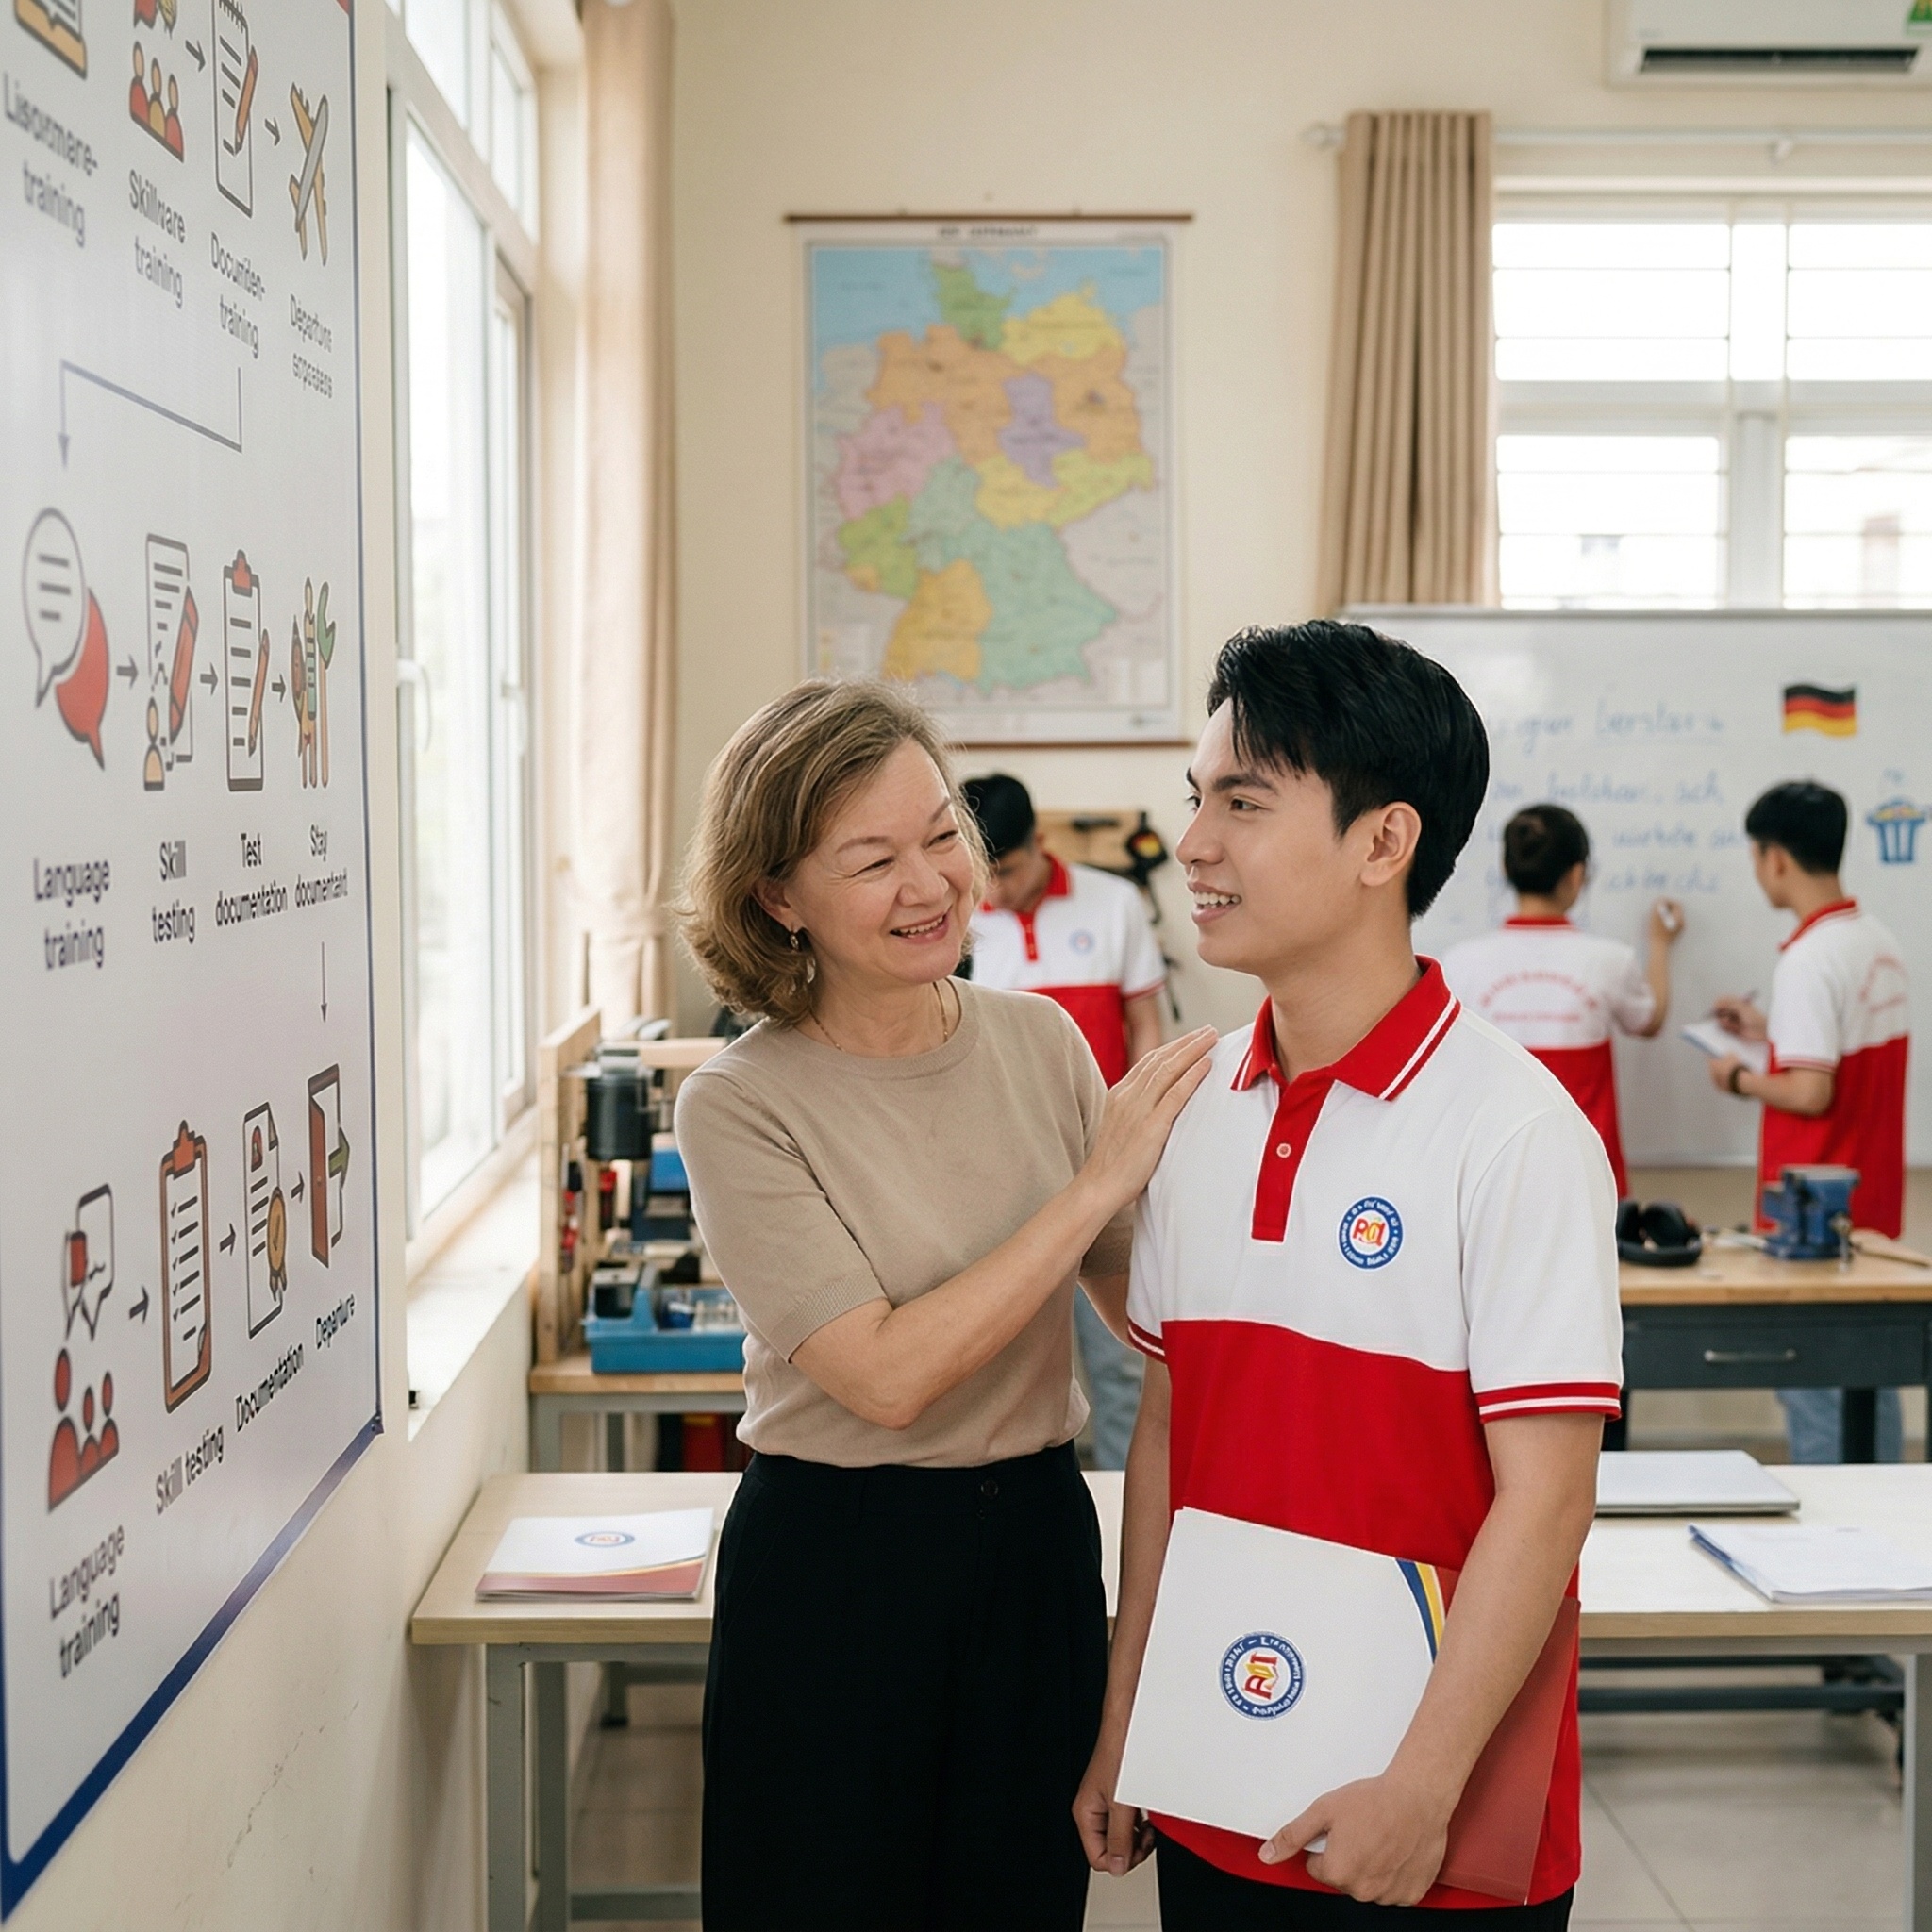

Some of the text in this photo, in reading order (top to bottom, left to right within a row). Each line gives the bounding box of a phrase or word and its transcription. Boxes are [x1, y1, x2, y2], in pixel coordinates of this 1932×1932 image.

[23, 161, 85, 248] training
[134, 236, 182, 309] training
[220, 295, 258, 359] training
[160, 841, 186, 881] Skill
[241, 833, 262, 867] Test
[310, 824, 327, 861] Stay
[34, 858, 109, 908] Language
[216, 880, 287, 926] documentation
[44, 920, 104, 971] training
[152, 900, 194, 944] testing
[236, 1343, 303, 1432] Documentation
[156, 1426, 224, 1515] Skill testing
[50, 1525, 125, 1621] Language
[59, 1593, 120, 1679] training
